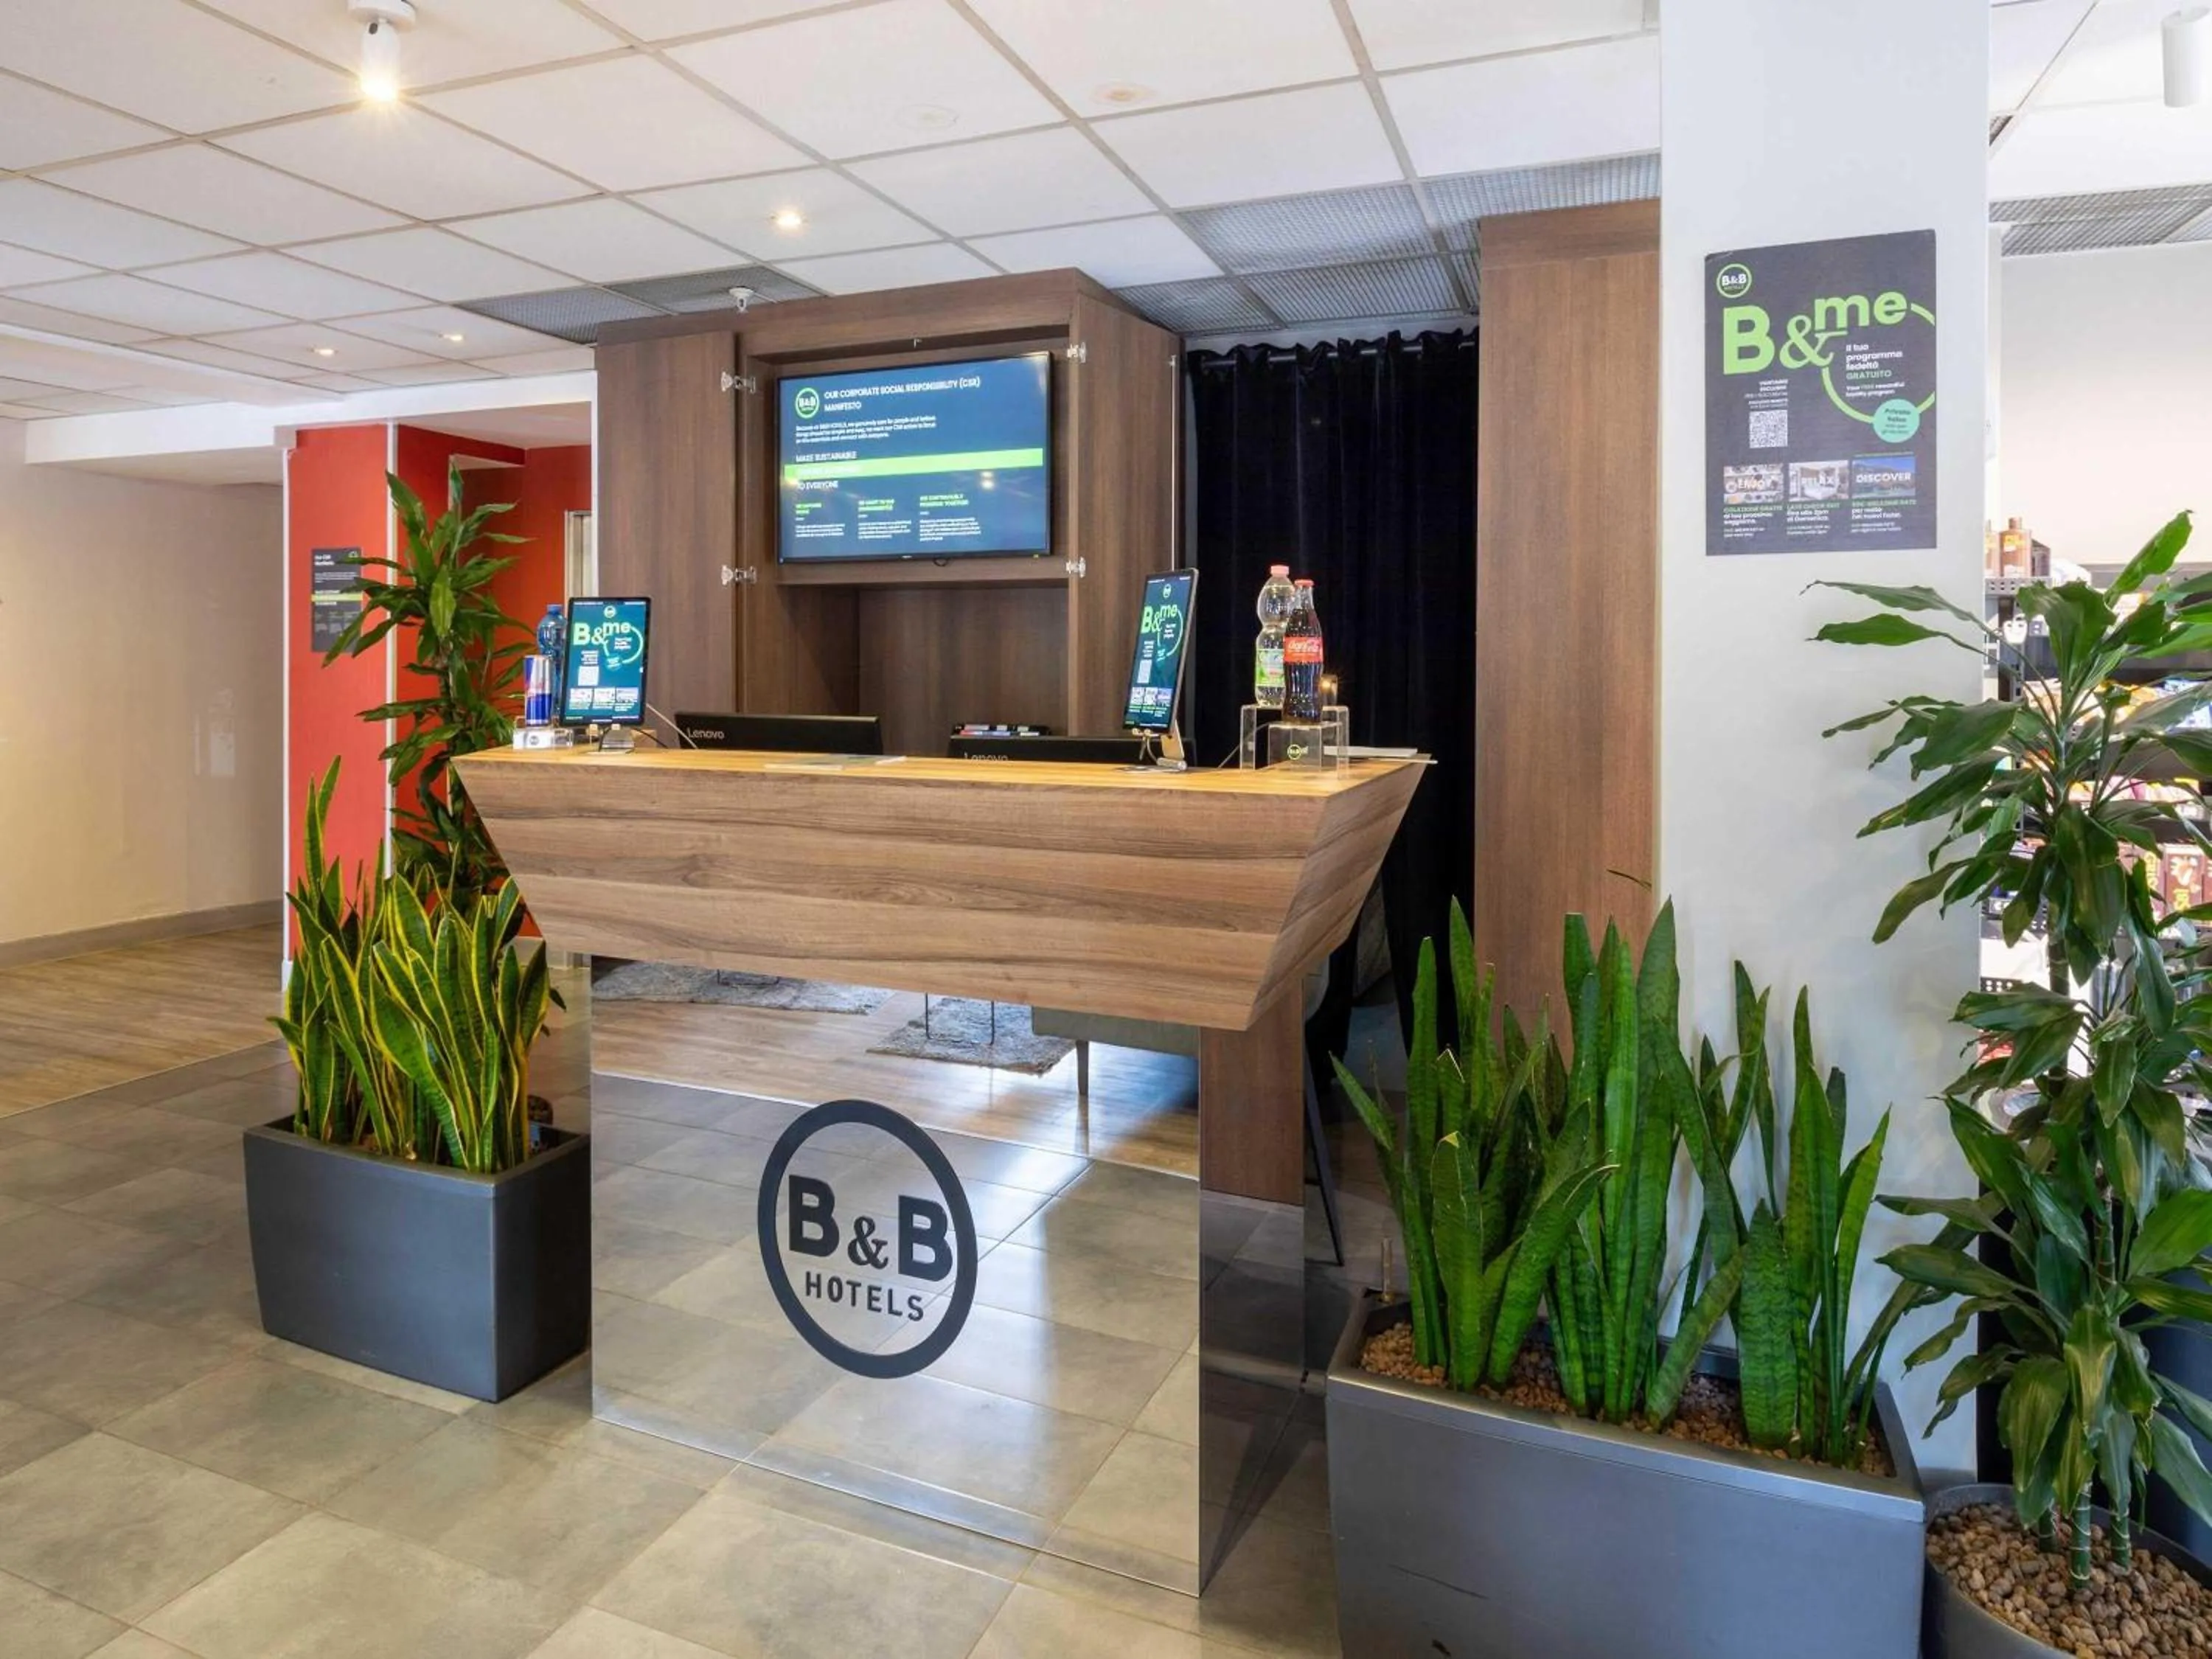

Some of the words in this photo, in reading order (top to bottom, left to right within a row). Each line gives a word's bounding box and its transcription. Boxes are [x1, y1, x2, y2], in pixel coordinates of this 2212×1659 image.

[1722, 274, 1746, 286] B&B
[1723, 291, 1908, 375] B&me
[1853, 344, 1869, 352] tuo
[1846, 351, 1903, 364] programma
[1846, 369, 1893, 380] GRATUITO
[824, 390, 838, 399] OUR
[840, 386, 880, 397] CORPORATE
[880, 383, 904, 395] SOCIAL
[905, 380, 958, 393] RESPONSIBILITY
[959, 375, 980, 389] (CSR)
[824, 400, 862, 411] MANIFESTO
[815, 451, 857, 461] SUSTAINABLE
[1856, 472, 1911, 483] DISCOVER
[806, 480, 838, 490] EVERYONE
[1141, 604, 1178, 634] B&me
[573, 622, 632, 646] B&me
[686, 726, 725, 740] Lenovo
[788, 1175, 953, 1282] B&B
[805, 1270, 924, 1322] HOTELS
